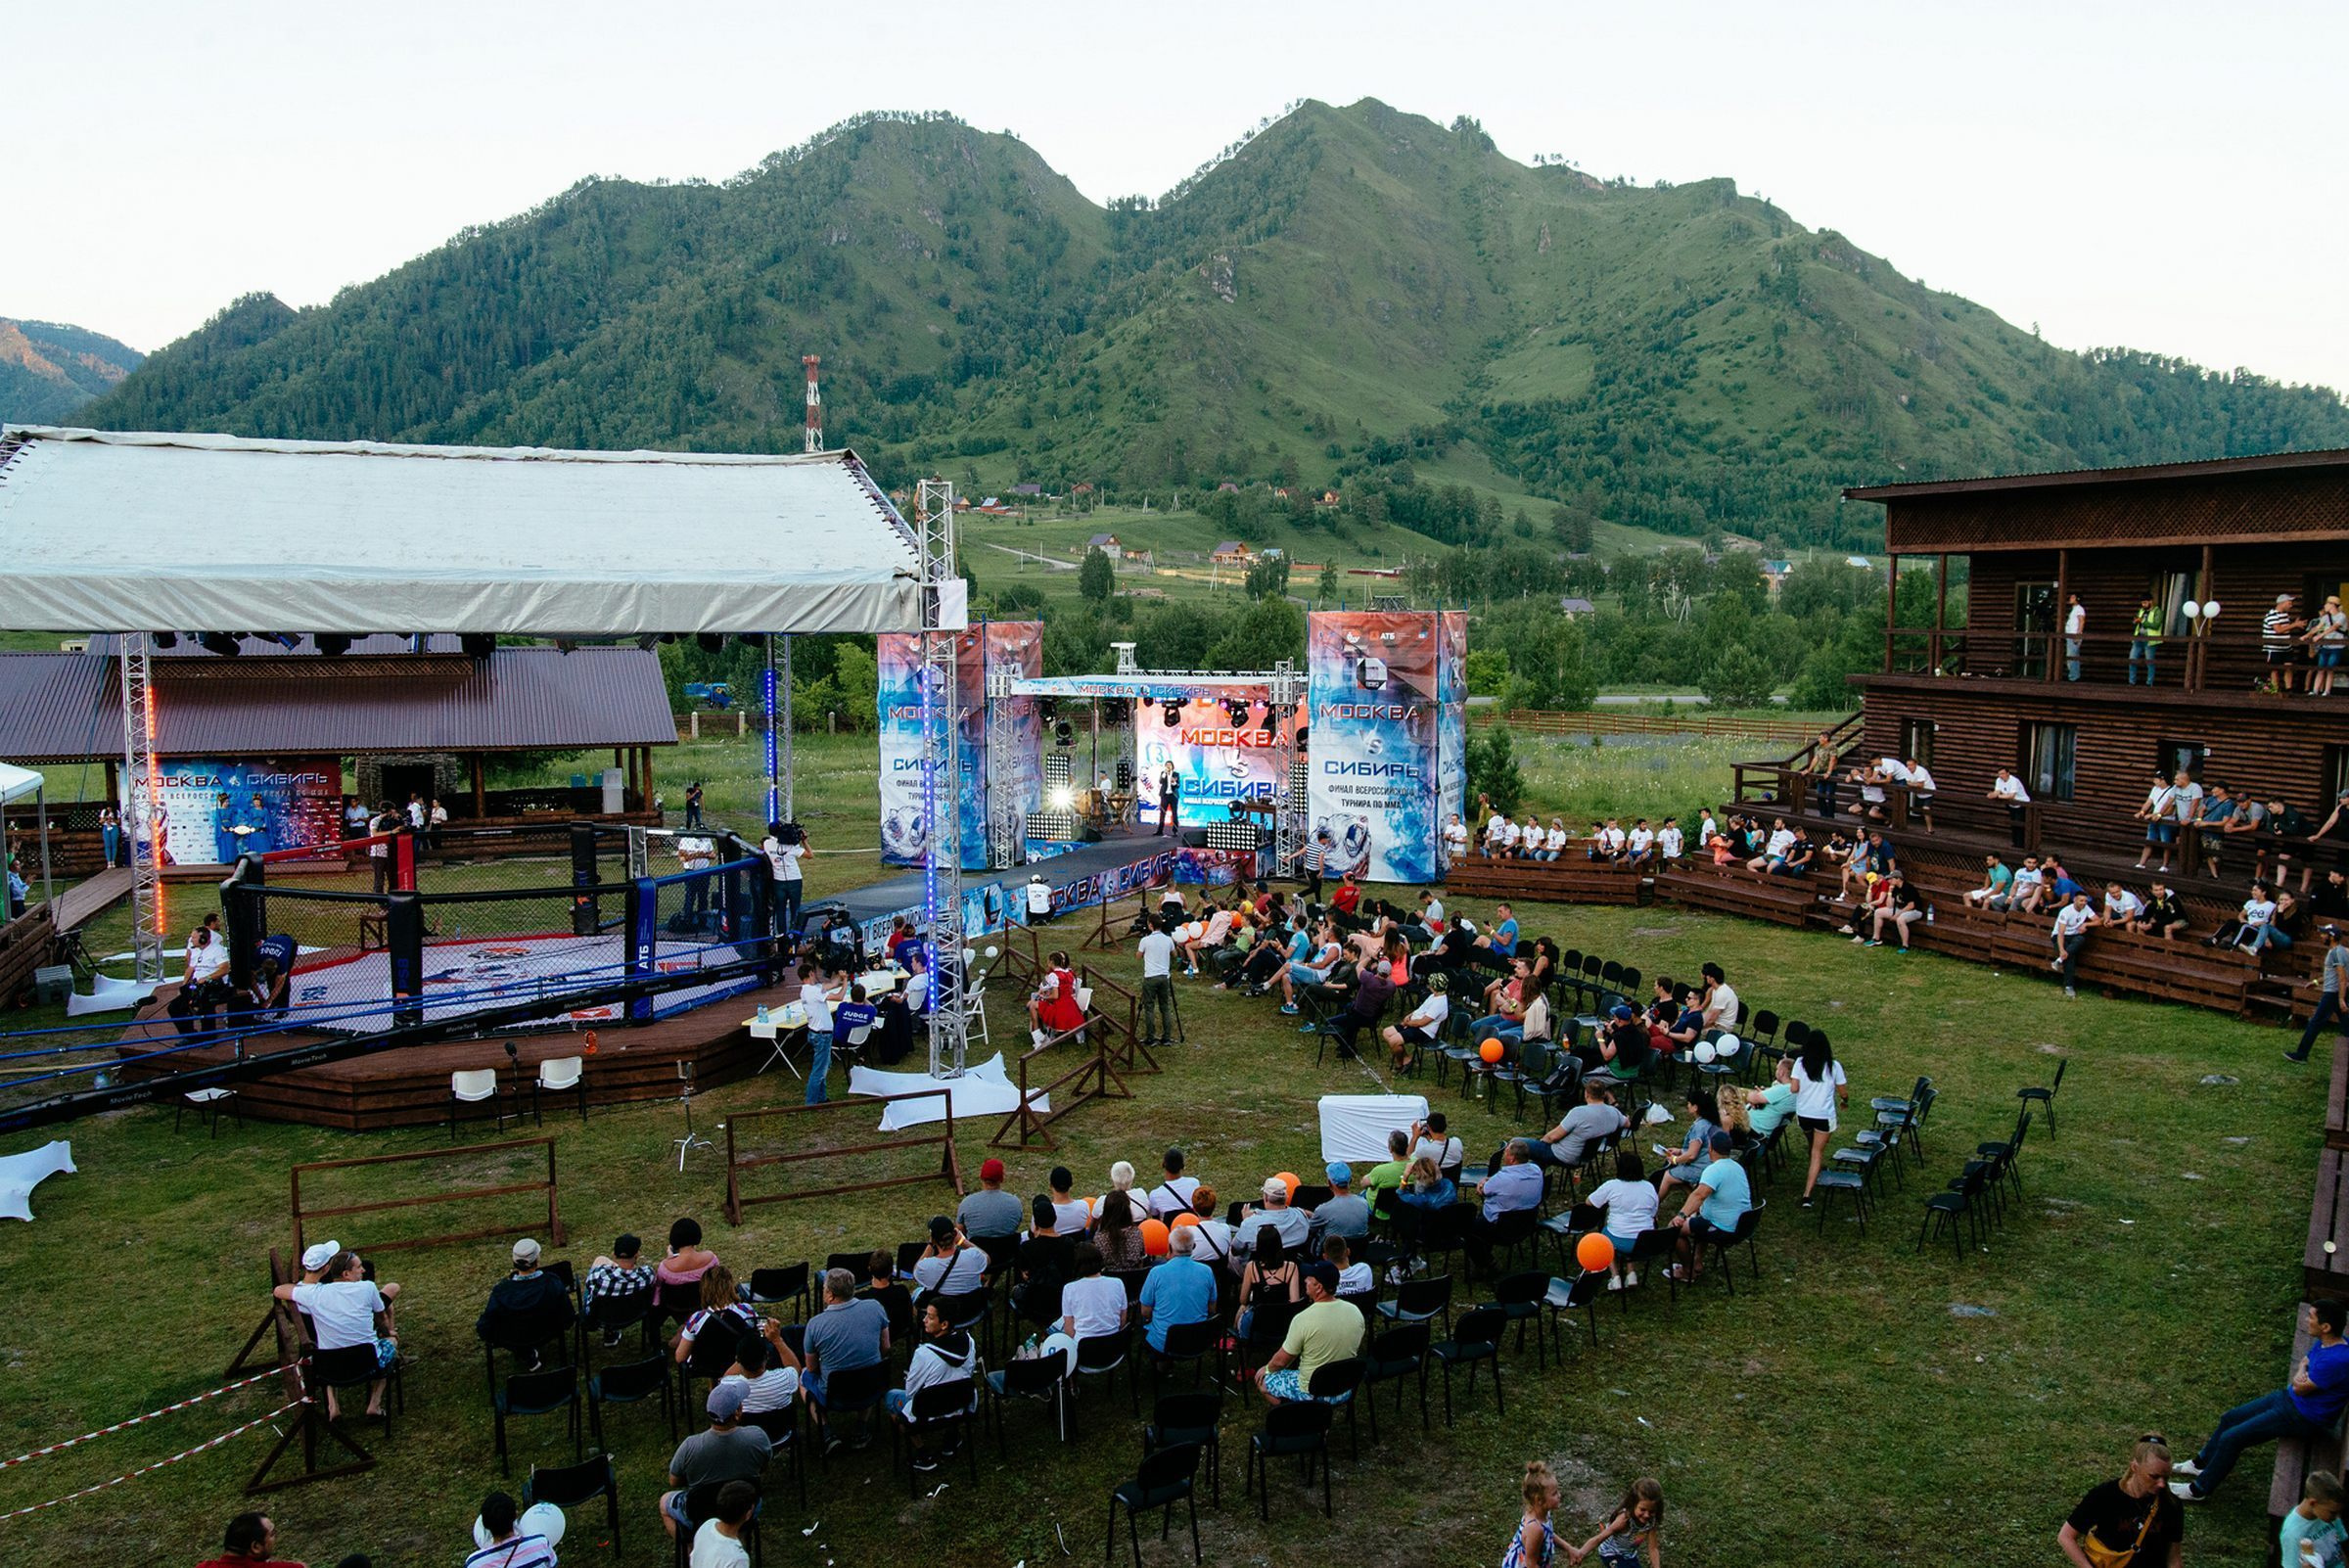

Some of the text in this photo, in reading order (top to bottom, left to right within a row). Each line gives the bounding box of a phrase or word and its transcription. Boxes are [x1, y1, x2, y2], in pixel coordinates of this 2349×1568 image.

[1080, 685, 1211, 697] МОСКВА СИБИРЬ
[1321, 704, 1420, 721] МОСКВА
[1180, 728, 1288, 747] МОСКВА
[1324, 760, 1419, 778] СИБИРЬ
[135, 772, 328, 788] МОСКВА СИБИРЬ
[1182, 779, 1288, 798] СИБИР
[1328, 784, 1354, 794] ФИНАЛ
[1341, 798, 1402, 809] ТУРНИРА ПО ММА
[1119, 851, 1176, 891] СИБИРЬ
[638, 945, 649, 970] АТБ
[844, 1010, 868, 1019] JUDGE
[110, 1090, 153, 1105] MovieTech
